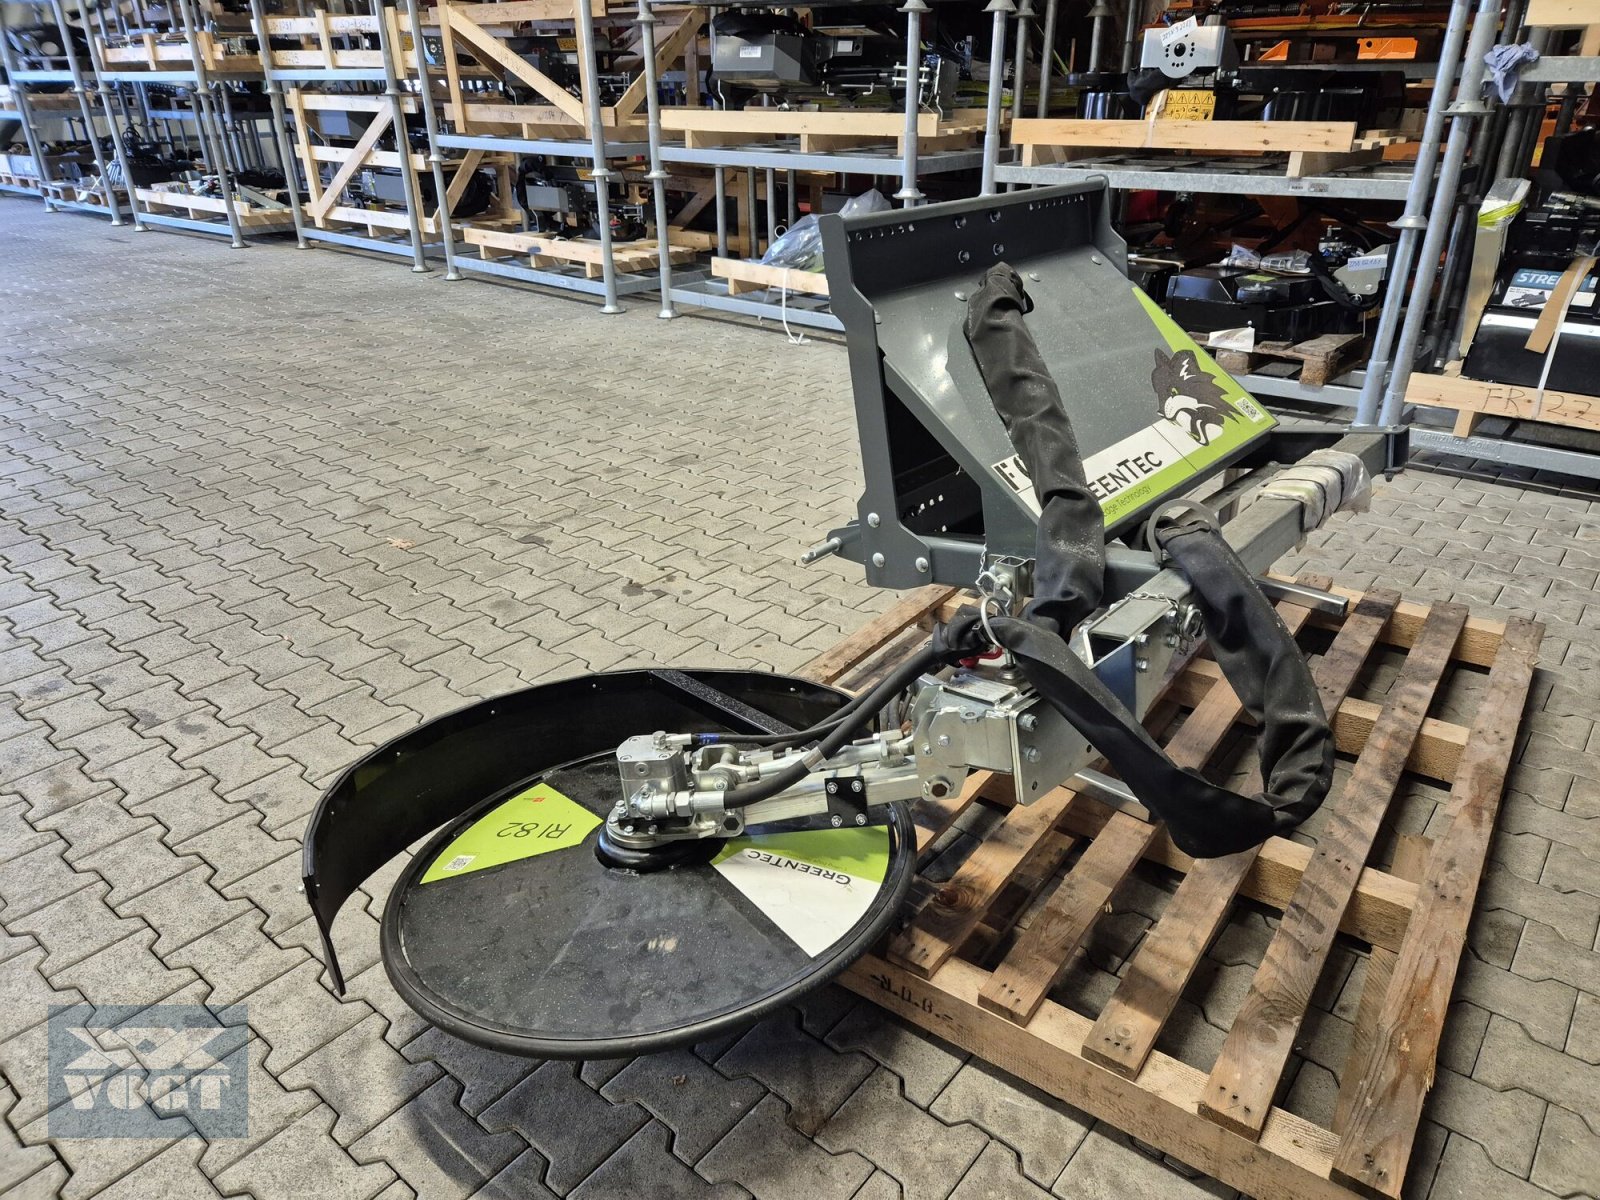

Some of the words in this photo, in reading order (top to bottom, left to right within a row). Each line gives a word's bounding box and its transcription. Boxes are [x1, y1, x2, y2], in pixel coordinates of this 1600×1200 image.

[1482, 387, 1525, 413] FR
[1086, 451, 1163, 501] EENTEC
[1117, 484, 1152, 509] Technology
[496, 822, 540, 838] 82
[747, 850, 851, 885] GREENTEC
